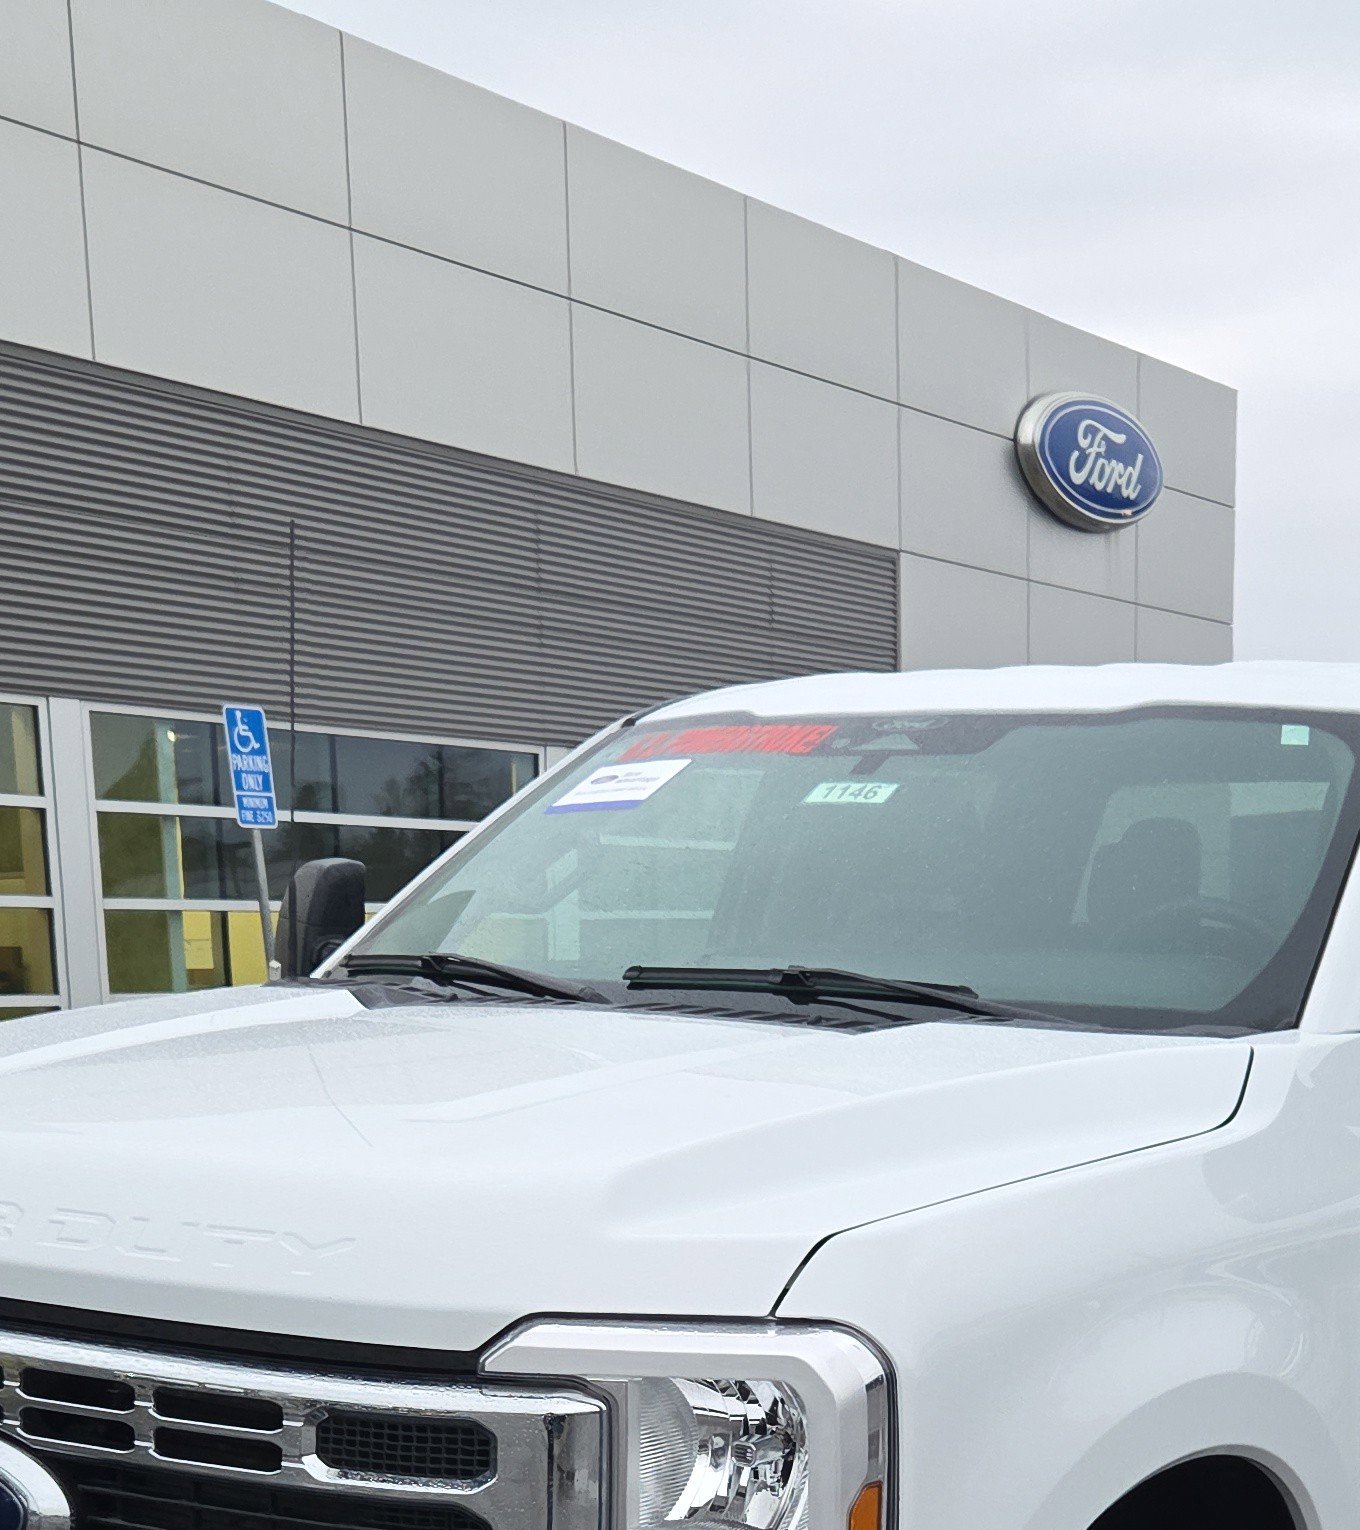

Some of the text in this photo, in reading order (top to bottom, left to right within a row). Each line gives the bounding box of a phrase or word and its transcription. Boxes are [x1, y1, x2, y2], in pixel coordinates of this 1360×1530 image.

[1069, 419, 1143, 501] Ford
[231, 754, 269, 772] PARKING
[241, 772, 263, 791] ONLY
[822, 784, 882, 800] 1146
[36, 1206, 358, 1276] DUTY
